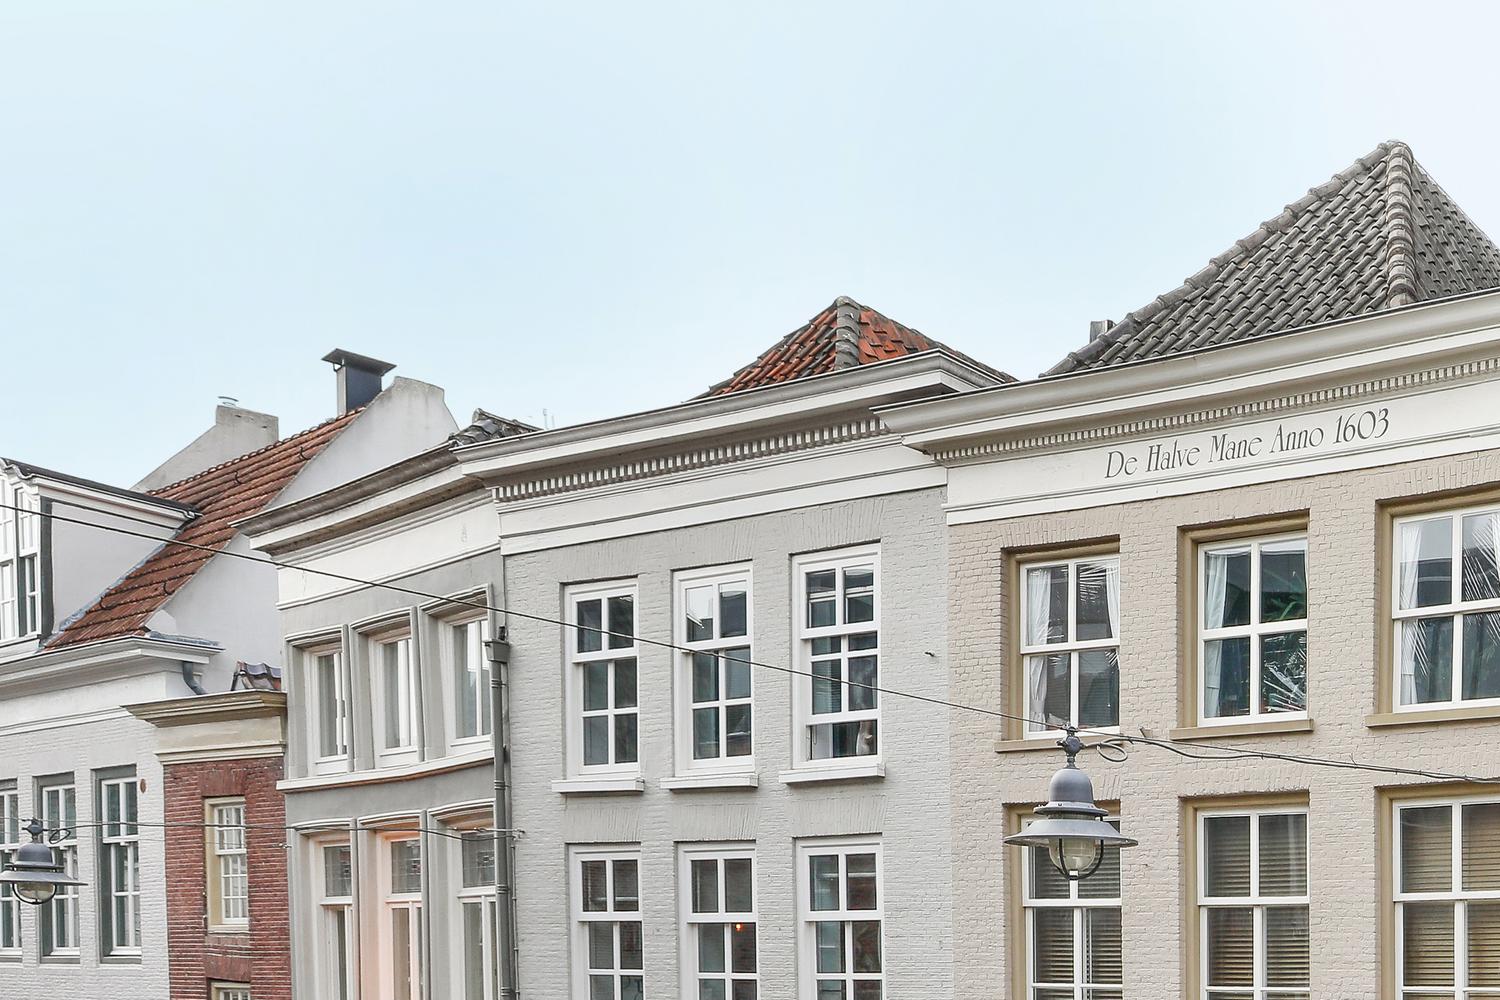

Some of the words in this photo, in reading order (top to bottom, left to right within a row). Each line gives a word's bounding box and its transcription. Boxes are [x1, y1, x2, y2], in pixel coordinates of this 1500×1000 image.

[1104, 450, 1138, 479] De
[1145, 439, 1201, 473] Halve
[1207, 433, 1263, 463] Mane
[1269, 424, 1325, 454] Anno
[1332, 407, 1390, 445] 1603
